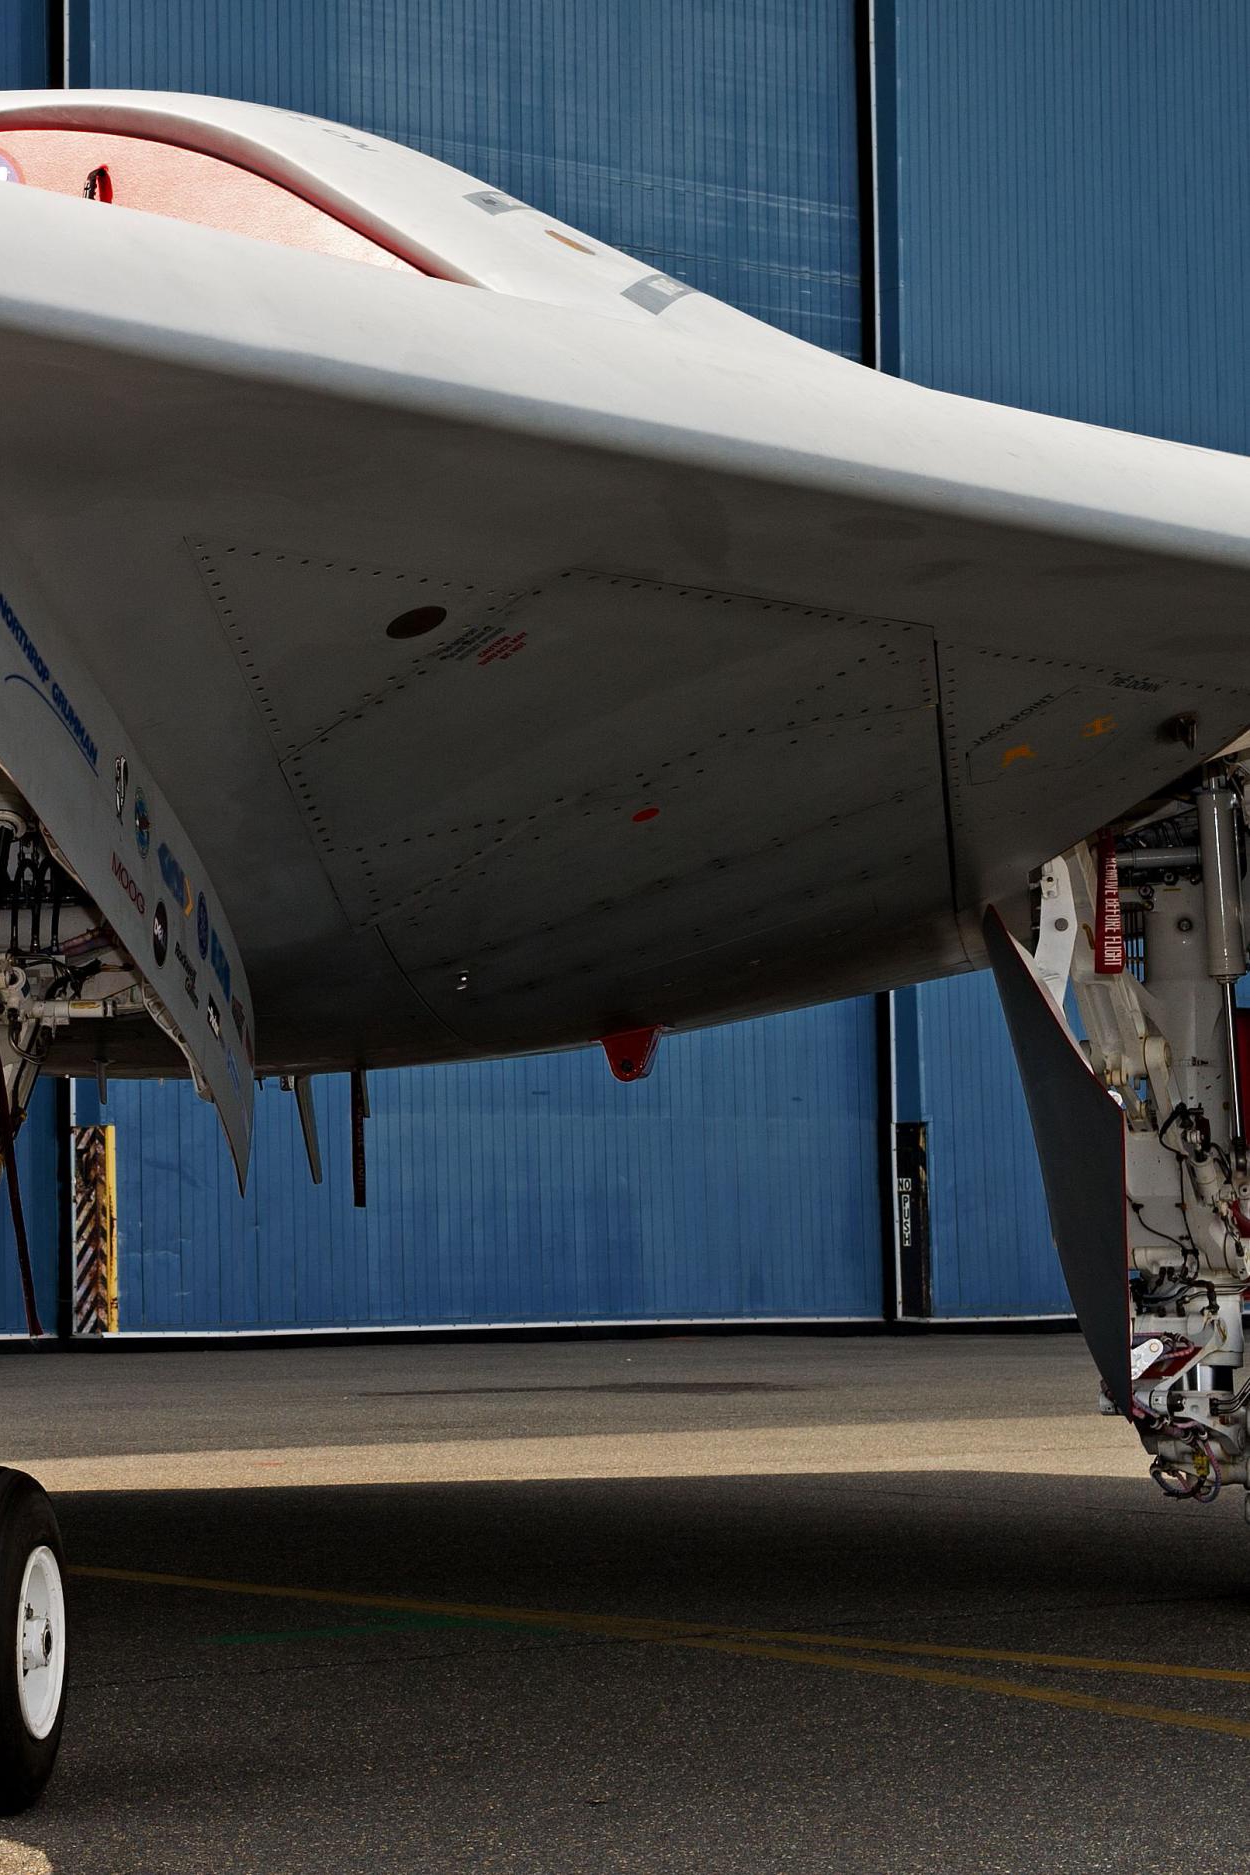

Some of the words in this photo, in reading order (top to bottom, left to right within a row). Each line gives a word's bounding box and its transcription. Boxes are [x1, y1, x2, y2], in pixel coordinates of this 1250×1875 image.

[51, 681, 98, 766] GRUMMAN
[972, 723, 1008, 746] JACK
[1009, 692, 1055, 723] POINT
[111, 852, 146, 915] MOOG
[1104, 857, 1119, 895] REMOVE
[1104, 898, 1122, 933] BEFORE
[1104, 936, 1124, 966] FLIGHT
[898, 1179, 911, 1190] NO
[902, 1196, 911, 1245] PUSH
